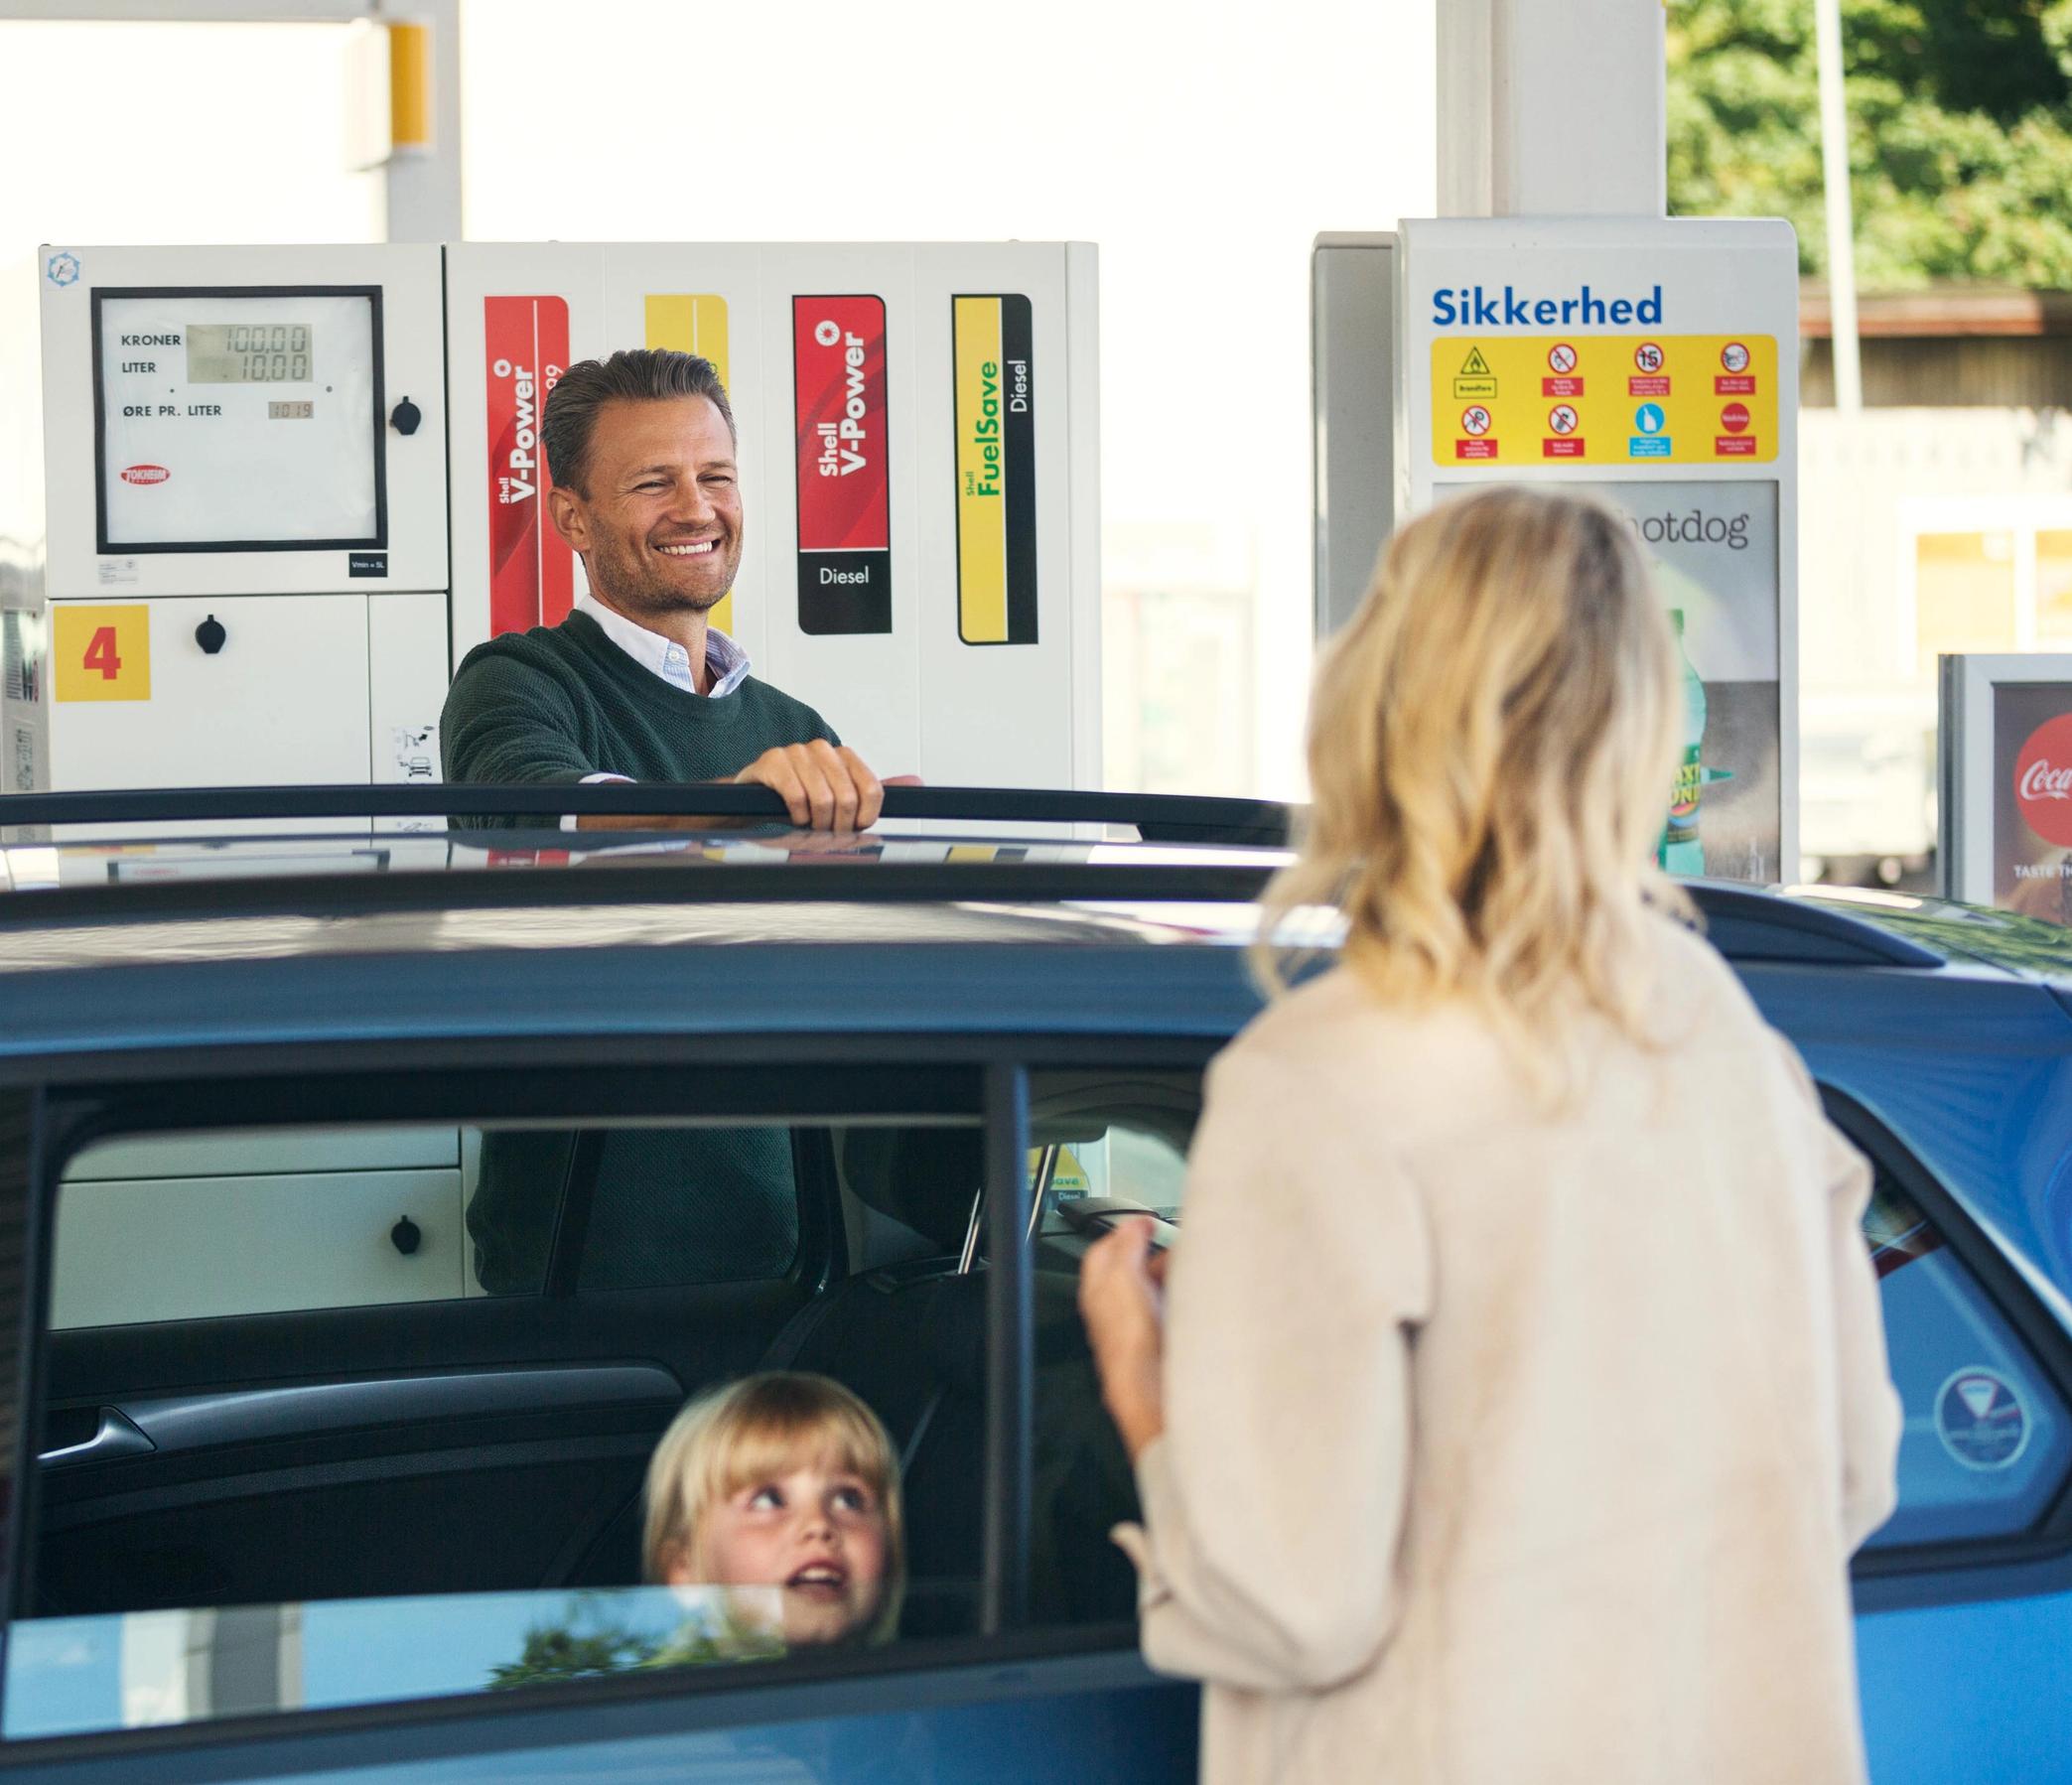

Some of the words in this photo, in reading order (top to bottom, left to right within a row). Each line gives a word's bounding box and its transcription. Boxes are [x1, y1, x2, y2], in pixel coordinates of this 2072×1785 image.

[1432, 286, 1663, 326] Sikkerhed
[121, 335, 182, 346] KRONER
[226, 326, 307, 354] 100,00
[121, 362, 156, 373] LITER
[242, 354, 308, 381] 10,00
[1639, 349, 1659, 367] 15
[1010, 359, 1029, 413] Diesel
[123, 405, 152, 417] ØRE
[159, 405, 182, 417] PR.
[188, 405, 222, 416] LITER
[274, 402, 313, 418] 1019
[840, 332, 867, 477] V-Power
[509, 365, 535, 504] V-Power
[974, 360, 1001, 497] FuelSave
[817, 422, 838, 477] Shell
[498, 478, 509, 504] Shell
[966, 472, 976, 497] Shell
[819, 566, 870, 585] Diesel
[83, 626, 122, 680] 4
[2013, 864, 2055, 879] TASTE
